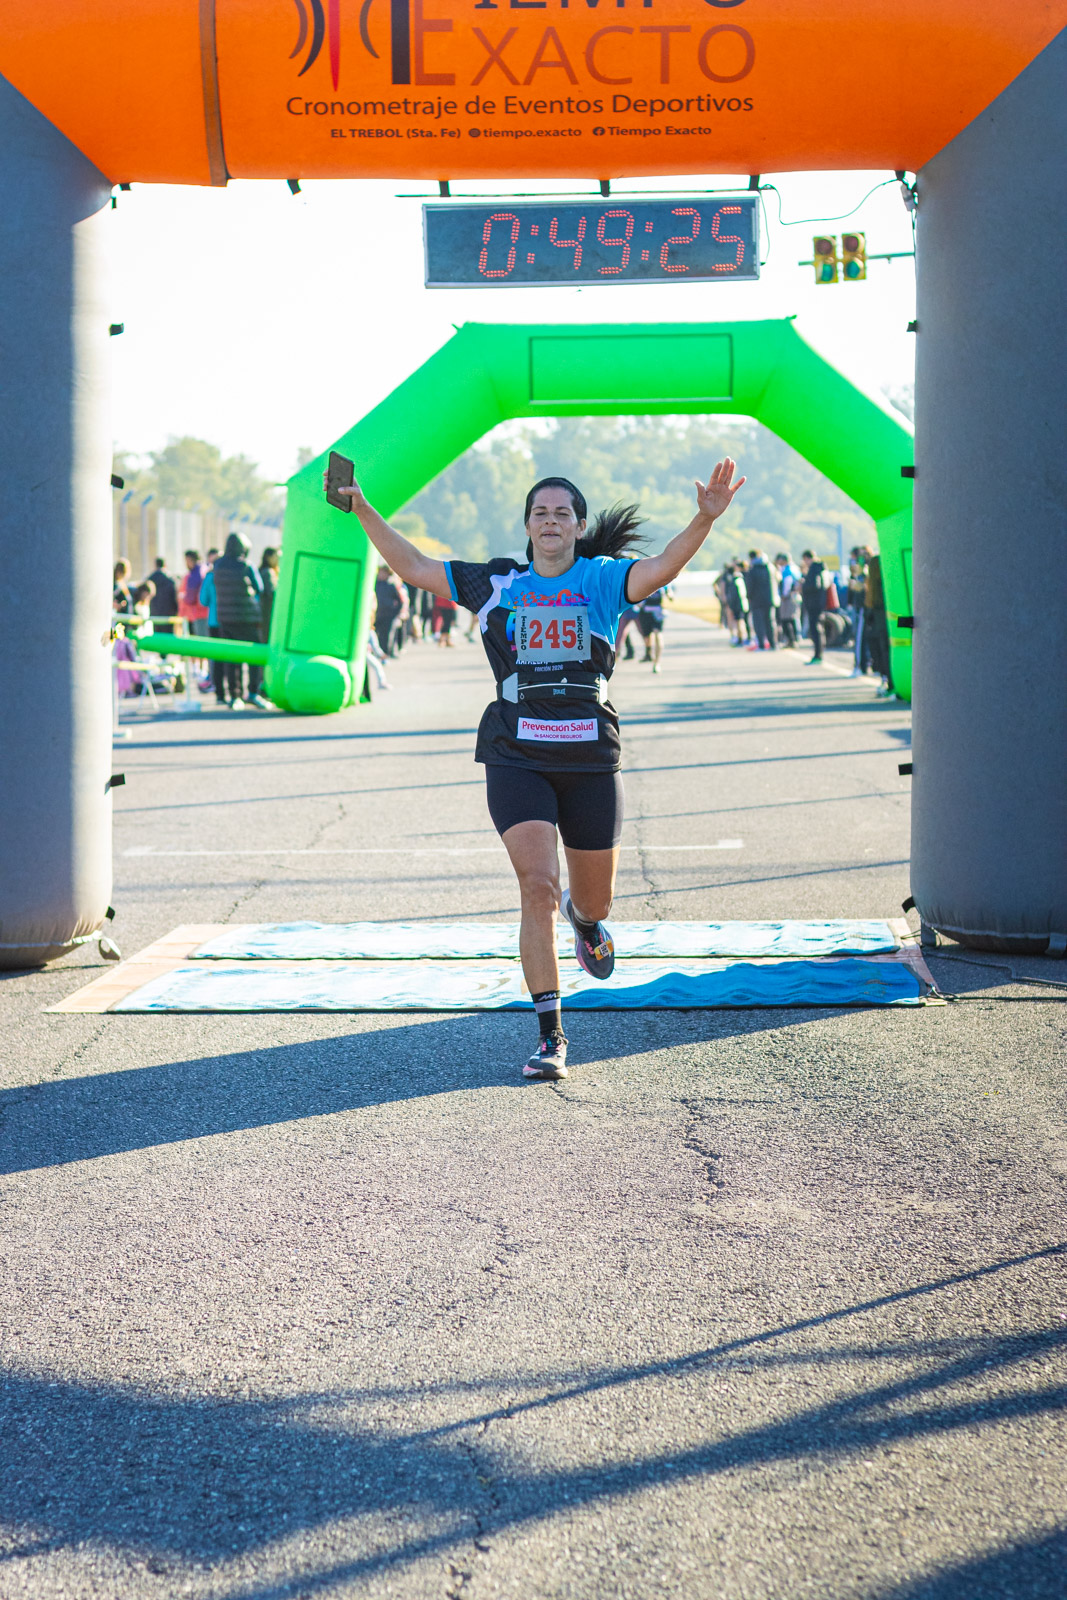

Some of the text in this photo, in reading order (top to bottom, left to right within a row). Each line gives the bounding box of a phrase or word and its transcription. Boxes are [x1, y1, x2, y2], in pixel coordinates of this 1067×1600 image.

[414, 0, 756, 87] EXACTO
[286, 94, 754, 119] Cronometraje de Eventos Deportivos
[331, 128, 461, 139] EL TREBOL (Sta. Fe)
[483, 127, 582, 139] tiempo.exacto
[608, 126, 712, 138] Tiempo Exacto
[478, 206, 745, 278] 0:49:25
[529, 619, 577, 649] 245
[576, 615, 584, 651] EXACTO
[522, 720, 594, 732] Prevención Salud
